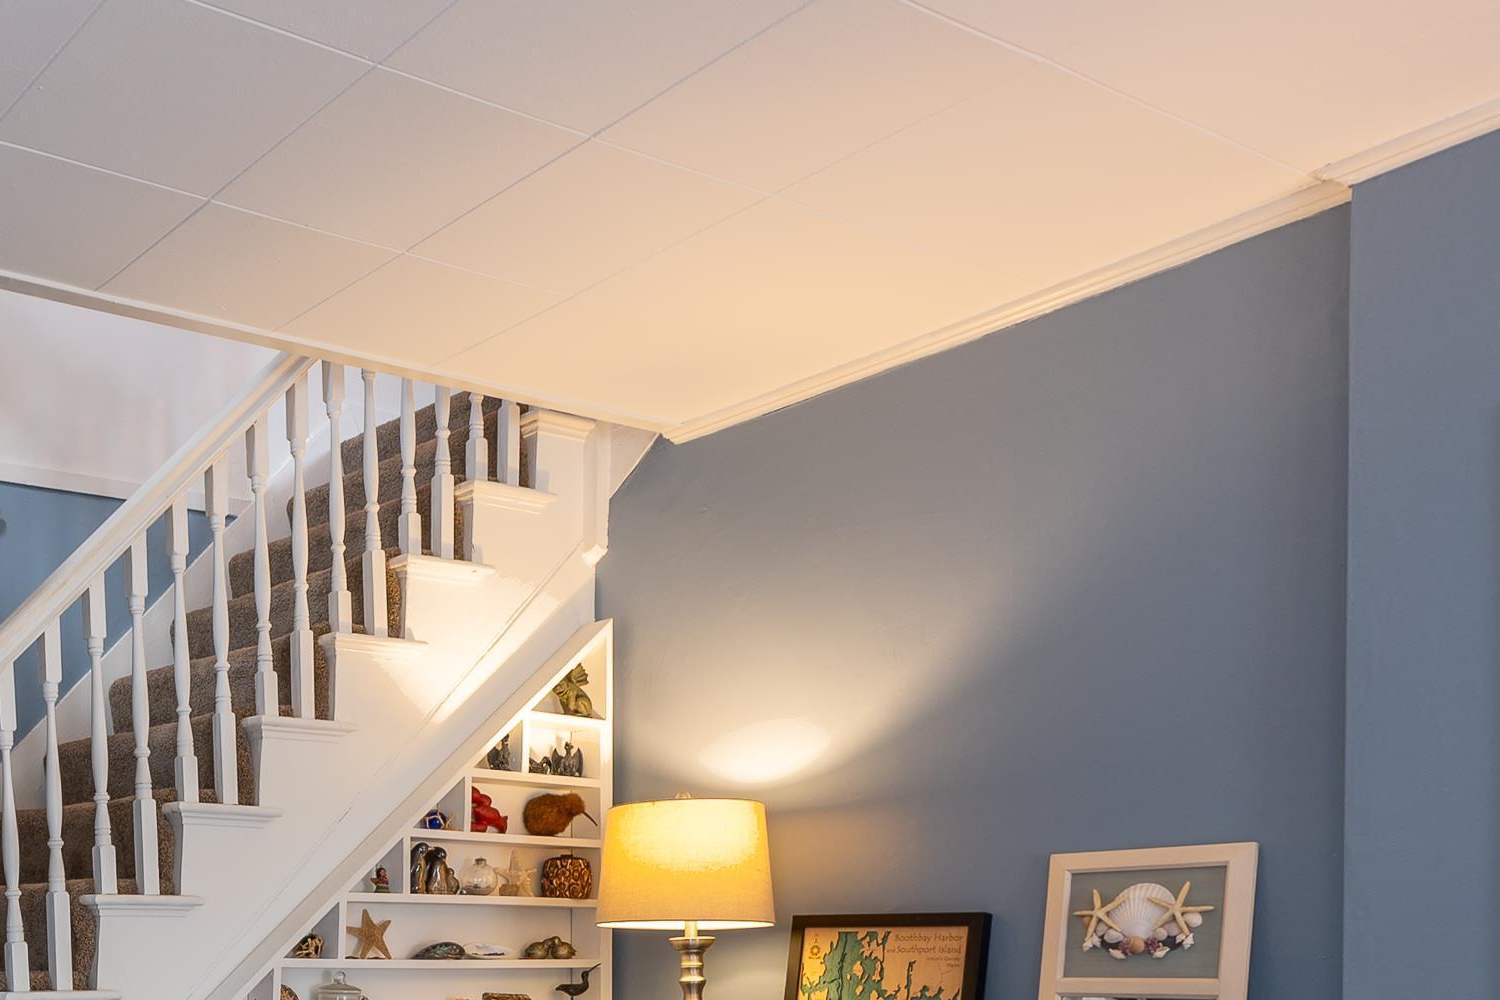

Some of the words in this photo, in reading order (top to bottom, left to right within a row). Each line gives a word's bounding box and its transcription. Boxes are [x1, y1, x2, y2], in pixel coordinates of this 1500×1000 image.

[895, 932, 933, 944] Boothbay
[934, 932, 964, 942] Harbor
[896, 944, 936, 955] Southport
[938, 945, 962, 954] Island
